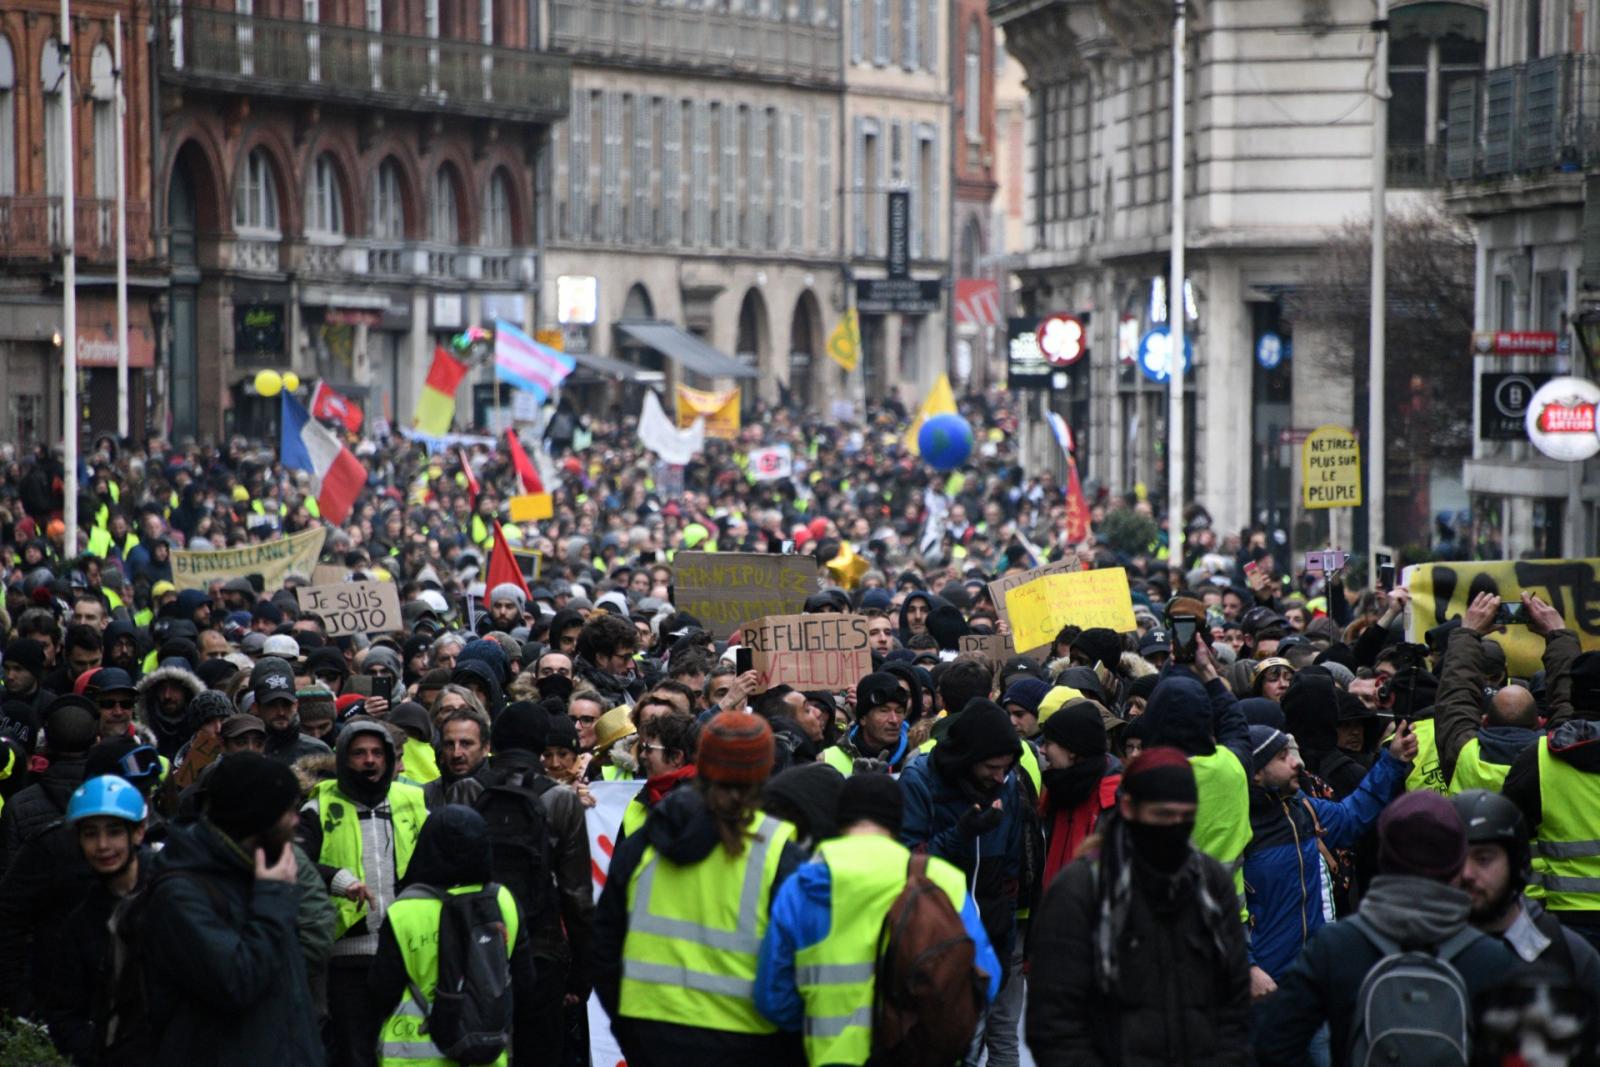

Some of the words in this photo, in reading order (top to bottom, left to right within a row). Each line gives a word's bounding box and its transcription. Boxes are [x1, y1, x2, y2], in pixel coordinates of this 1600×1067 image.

[1548, 406, 1593, 419] STELLA
[1547, 418, 1593, 431] ARTOIS
[1311, 440, 1325, 452] NE
[1310, 456, 1336, 468] PLUS
[1337, 455, 1357, 466] SUR
[1321, 470, 1336, 482] LE
[1309, 485, 1356, 501] PEUPLE
[324, 609, 386, 634] JOJO
[744, 619, 868, 652] REFUGEES
[965, 637, 989, 651] DE
[756, 650, 871, 686] WELCOME
